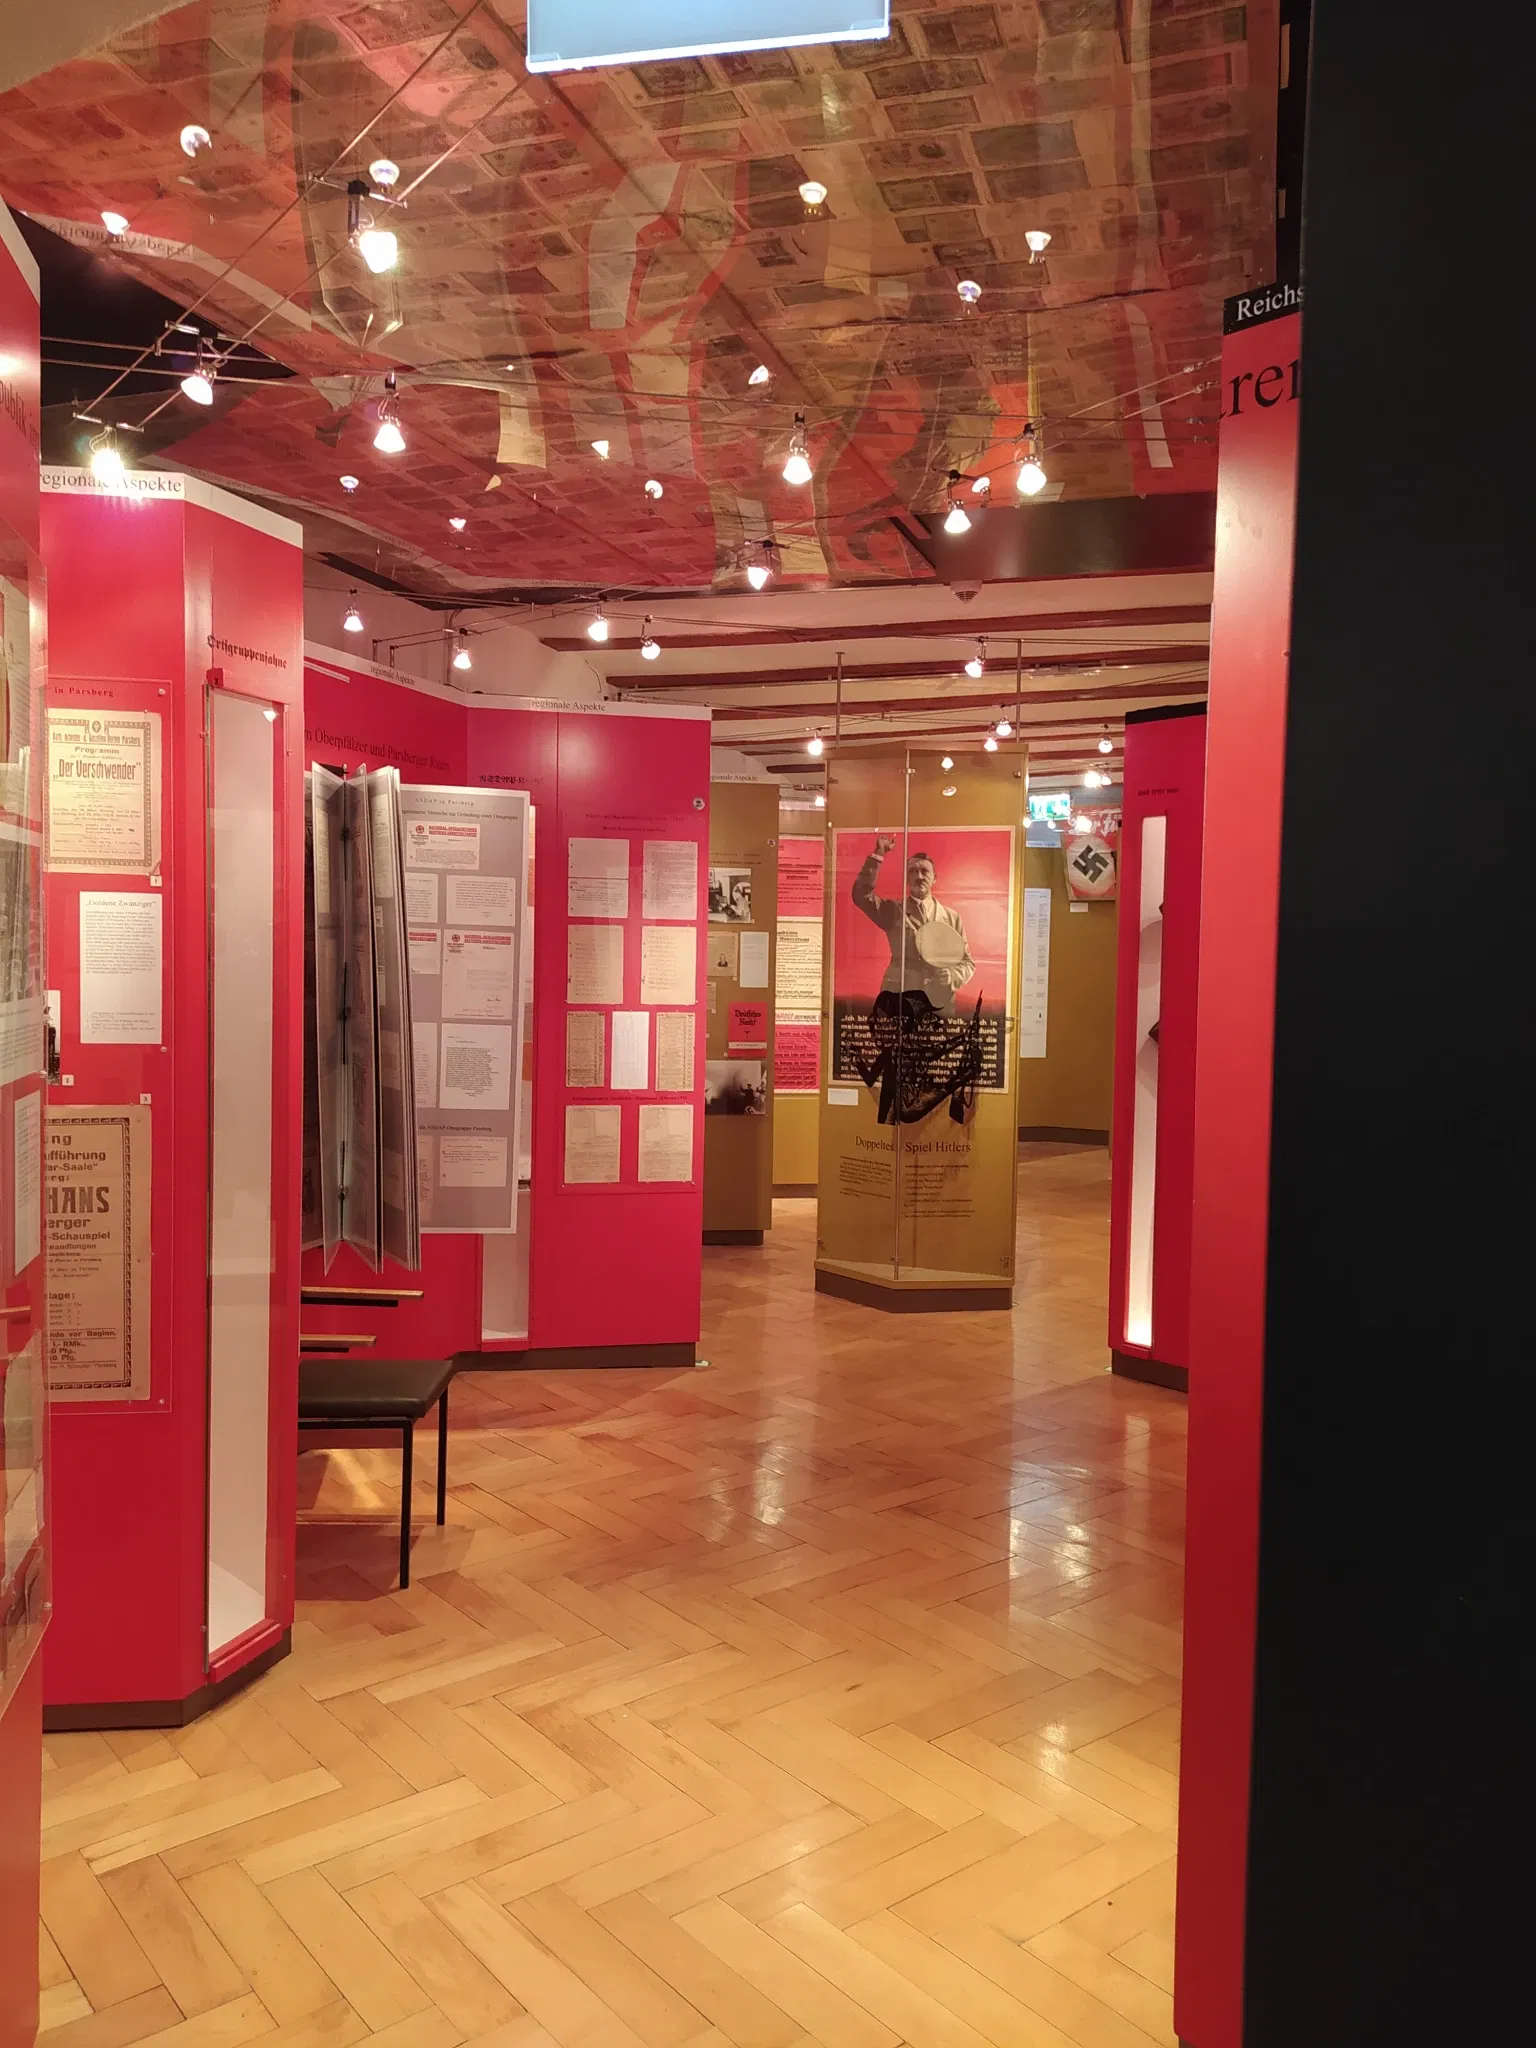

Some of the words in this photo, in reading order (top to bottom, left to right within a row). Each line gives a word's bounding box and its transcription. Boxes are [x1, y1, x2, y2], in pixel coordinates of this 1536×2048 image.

[1221, 357, 1304, 420] re
[69, 687, 114, 698] Parsberg
[532, 700, 571, 711] regionale
[572, 702, 606, 712] Aspekte
[75, 746, 120, 755] Programm
[855, 1135, 894, 1152] Doppeltes
[904, 1140, 932, 1154] Spiel
[935, 1141, 972, 1153] Hitlers
[47, 1150, 107, 1162] fführung
[47, 1218, 91, 1230] erger
[47, 1231, 110, 1242] -Schauspiel
